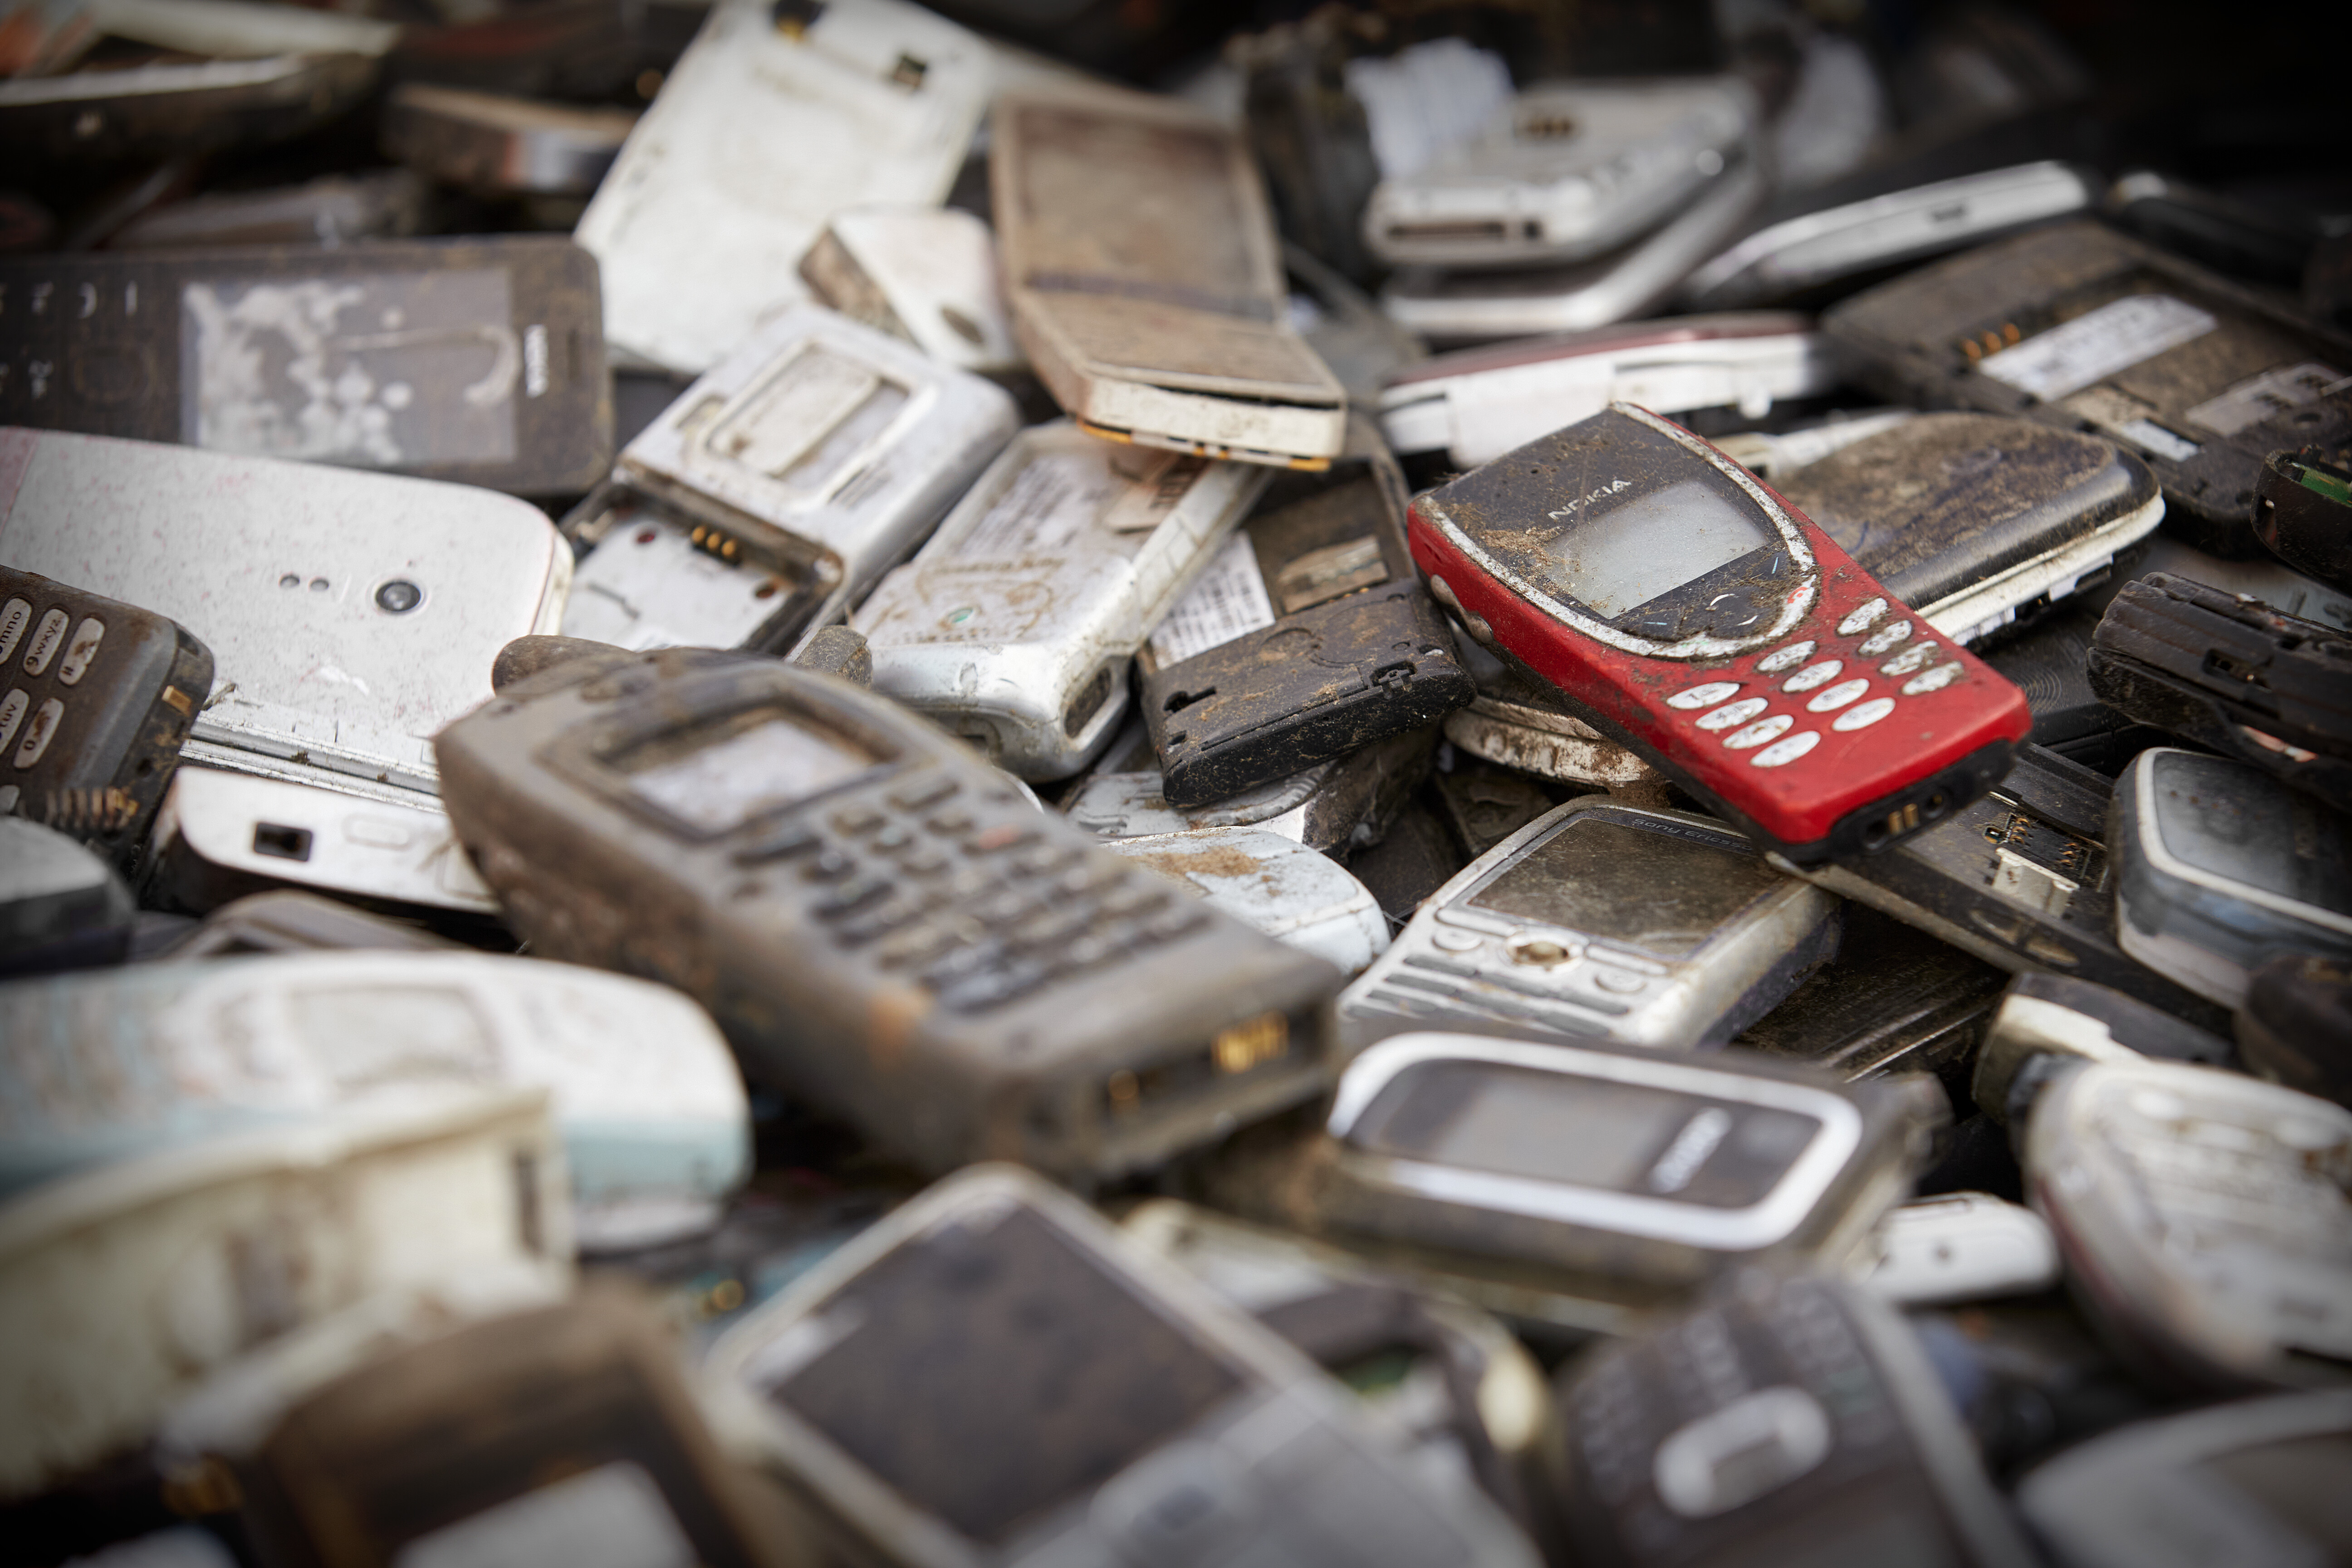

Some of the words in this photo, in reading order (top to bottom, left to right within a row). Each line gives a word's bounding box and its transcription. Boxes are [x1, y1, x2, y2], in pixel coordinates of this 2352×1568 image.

[1548, 480, 1632, 520] NOKIA
[1632, 818, 1681, 834] Sony
[1685, 830, 1753, 851] Ericsso
